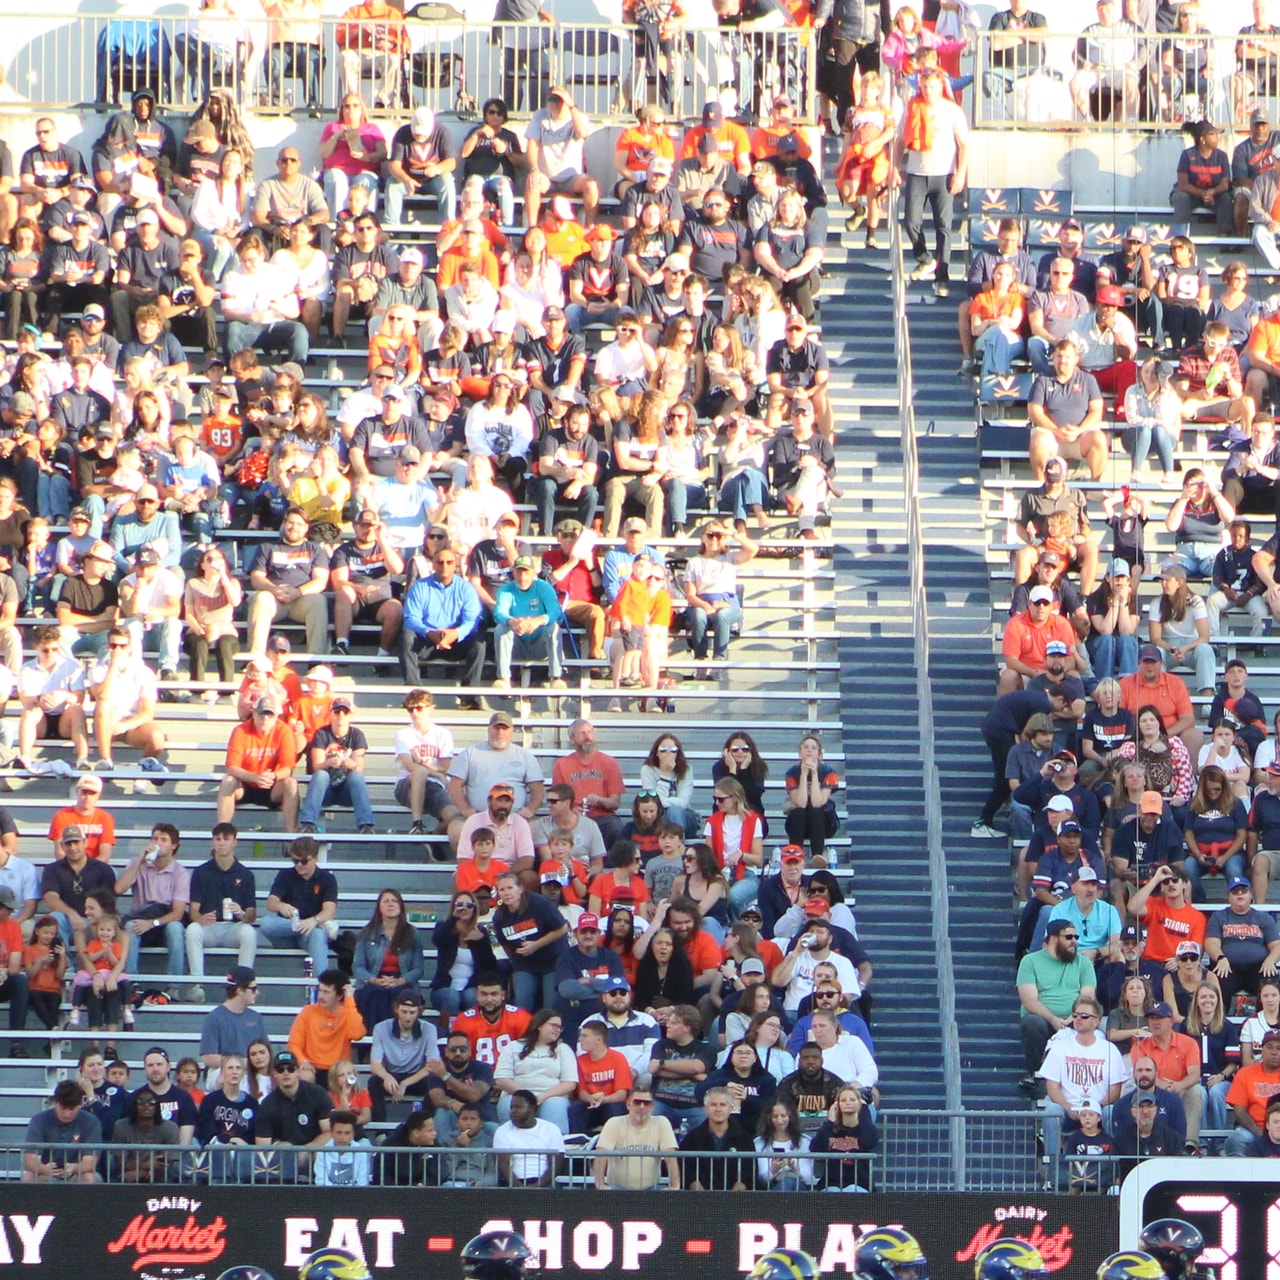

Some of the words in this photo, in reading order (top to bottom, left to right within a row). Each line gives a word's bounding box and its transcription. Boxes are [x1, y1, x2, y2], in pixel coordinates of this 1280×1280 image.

[1167, 274, 1199, 298] 19
[1231, 569, 1247, 590] 7
[1066, 1062, 1104, 1086] VIRGINIA
[147, 1196, 202, 1213] DAIRY
[994, 1205, 1048, 1222] DAIRY
[107, 1214, 228, 1255] Market
[284, 1218, 405, 1268] EAT
